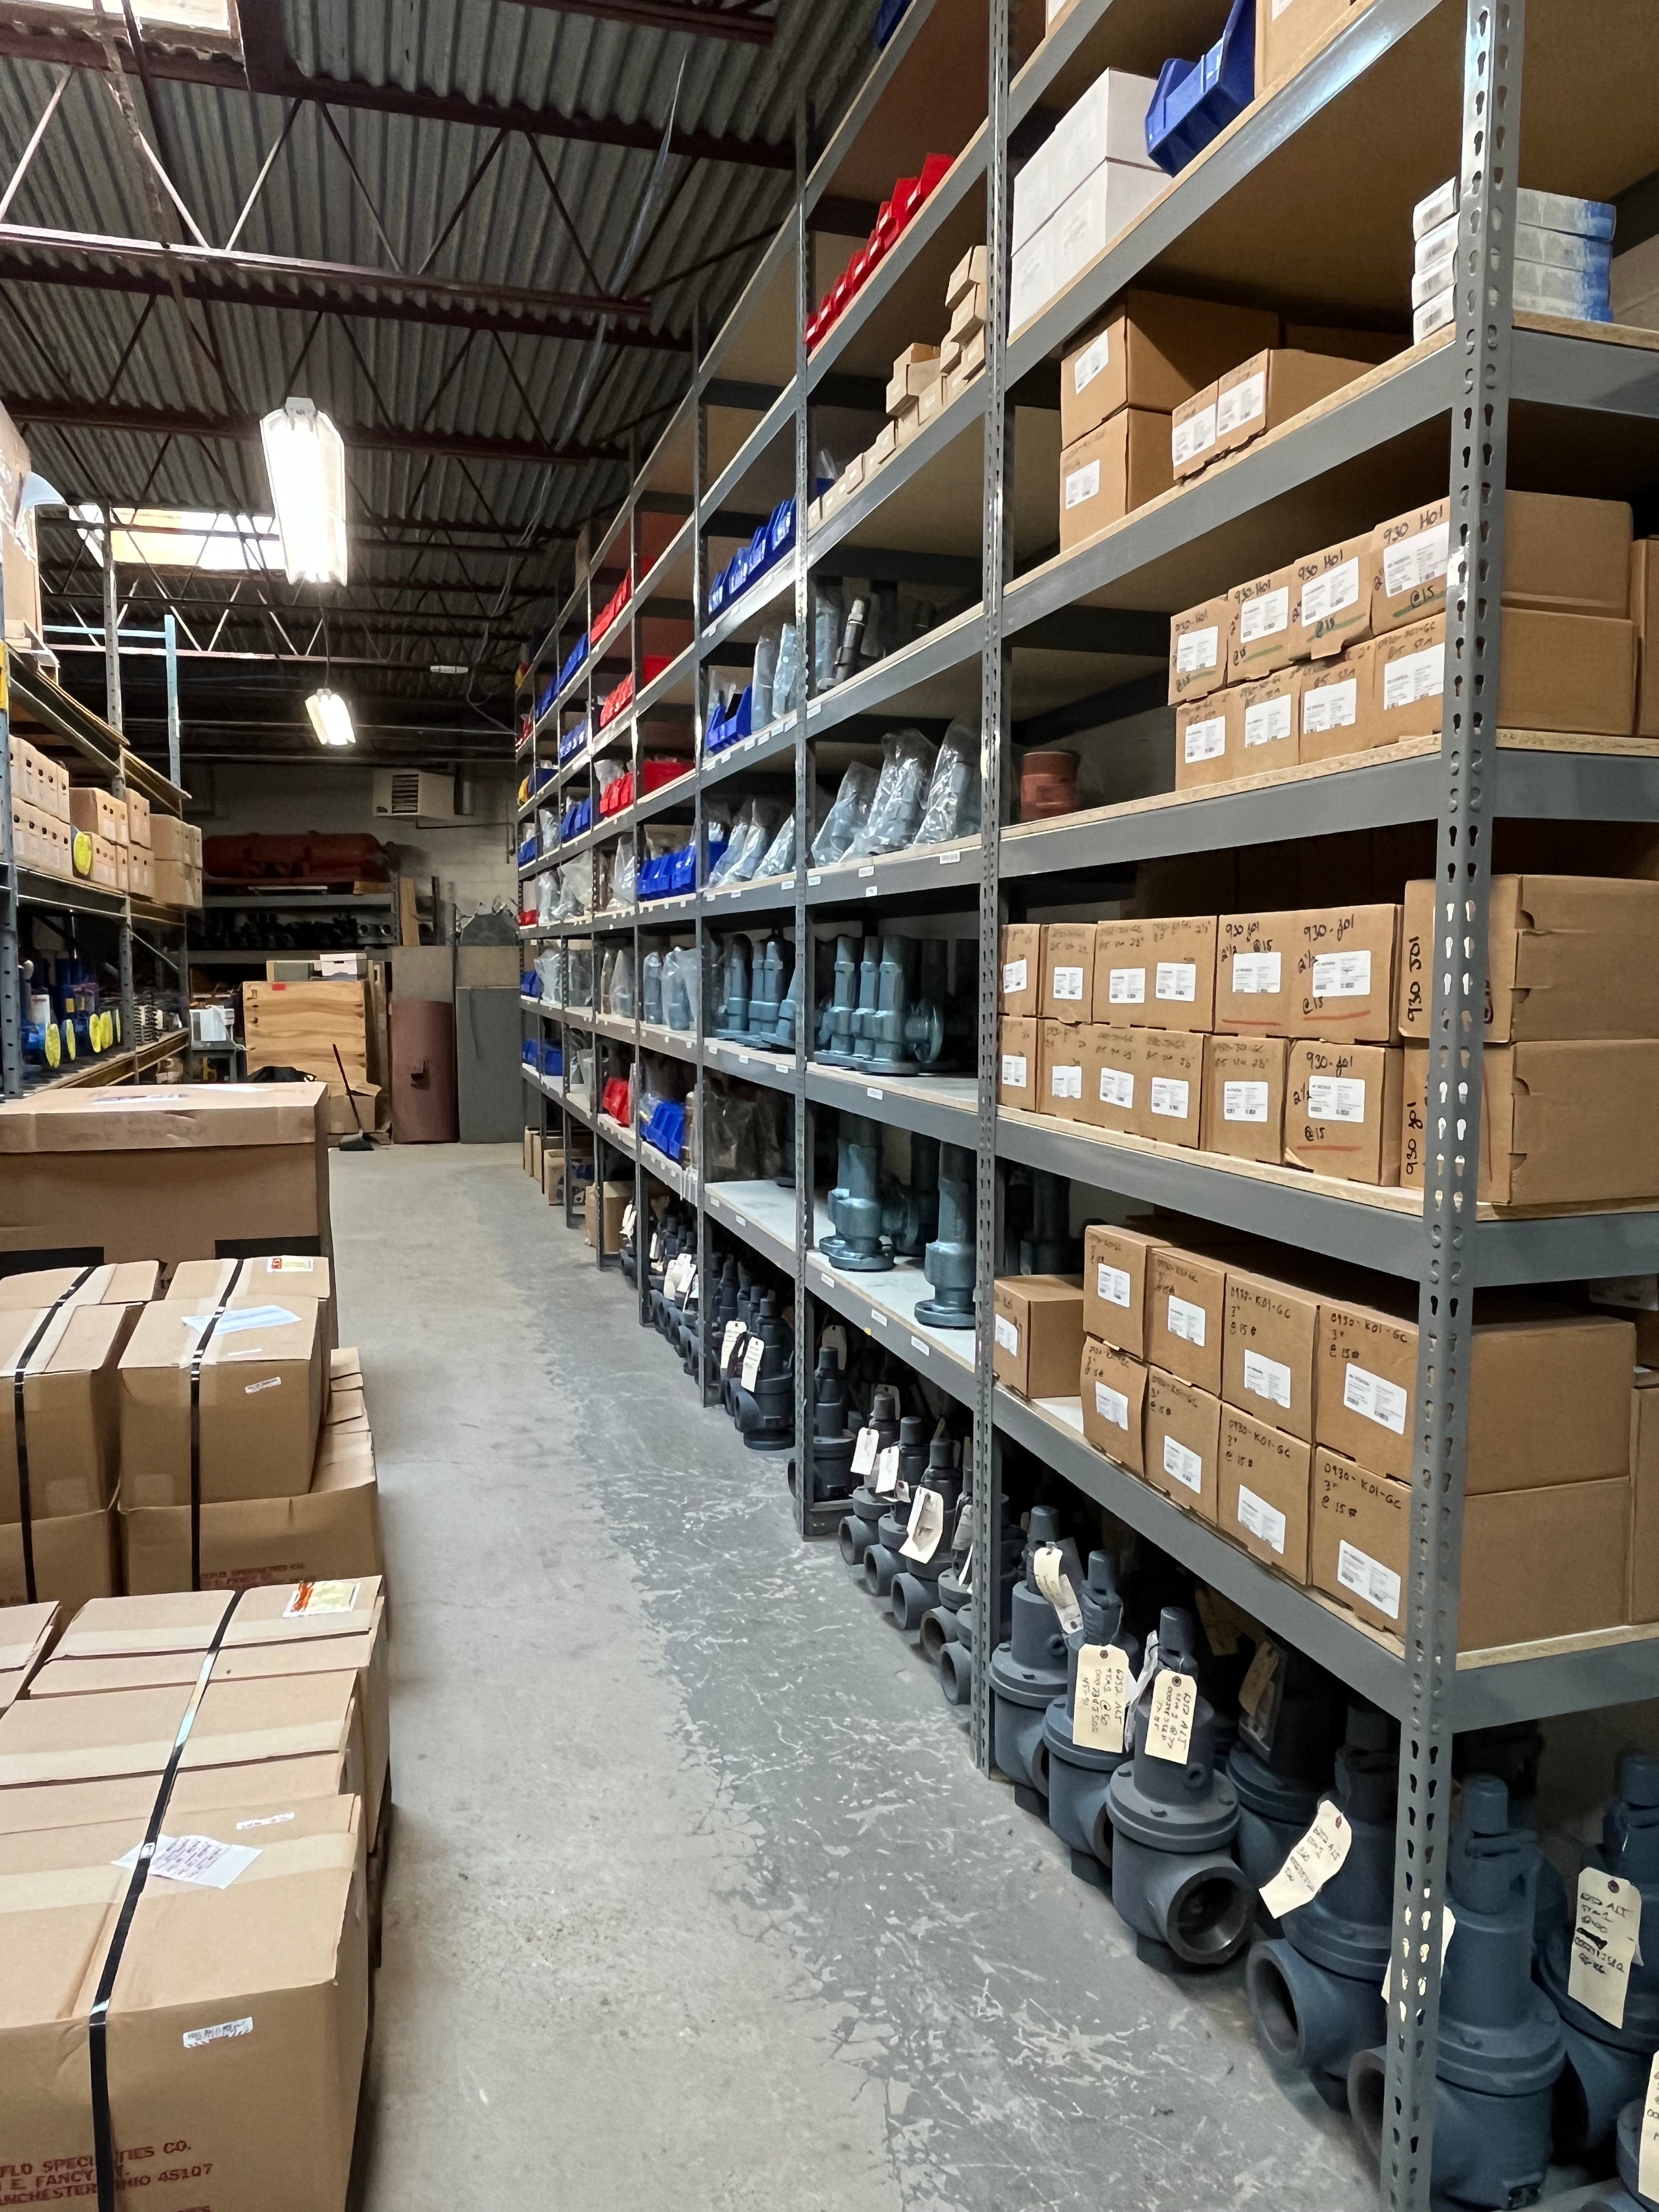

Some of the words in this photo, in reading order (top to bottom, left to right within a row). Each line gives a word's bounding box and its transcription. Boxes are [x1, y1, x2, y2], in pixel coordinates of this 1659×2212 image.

[1384, 522, 1409, 544] 930
[1226, 923, 1244, 939] 930
[1407, 981, 1423, 1022] 930
[1406, 1138, 1419, 1175] 930
[163, 2140, 191, 2154] CO.
[36, 2169, 94, 2190] FANCY
[157, 2163, 213, 2182] 45107
